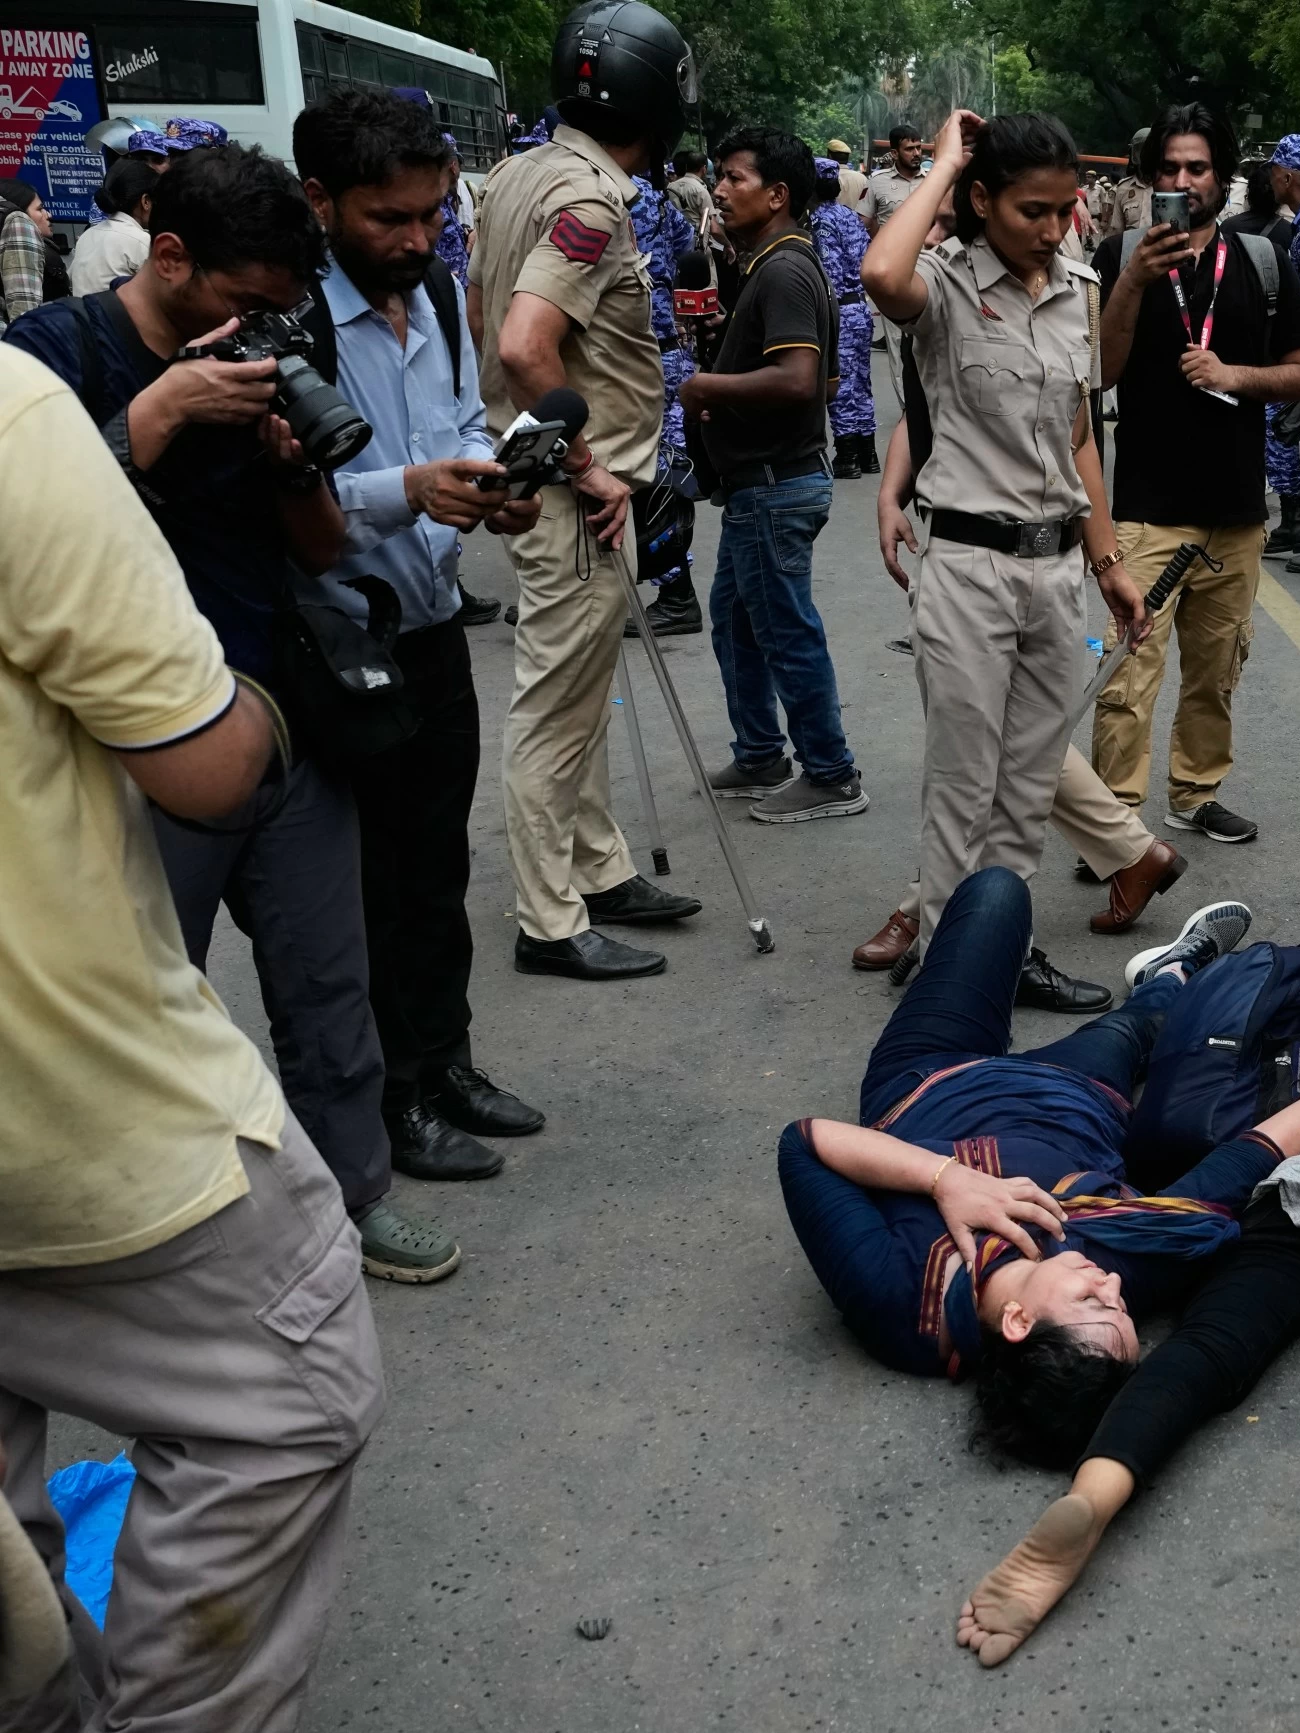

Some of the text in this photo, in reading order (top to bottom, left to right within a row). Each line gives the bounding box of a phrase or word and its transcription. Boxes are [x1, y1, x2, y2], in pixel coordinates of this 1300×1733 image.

[1, 29, 90, 59] PARKING
[106, 45, 159, 82] Shakshi
[8, 61, 47, 77] AWAY
[52, 63, 94, 79] ZONE
[24, 132, 48, 141] your
[24, 143, 59, 154] please
[23, 156, 43, 166] No.:
[49, 169, 71, 177] TRAFFIC
[51, 178, 84, 186] PARLIAMENT
[52, 201, 80, 209] POLICE
[1174, 284, 1186, 308] PRESS
